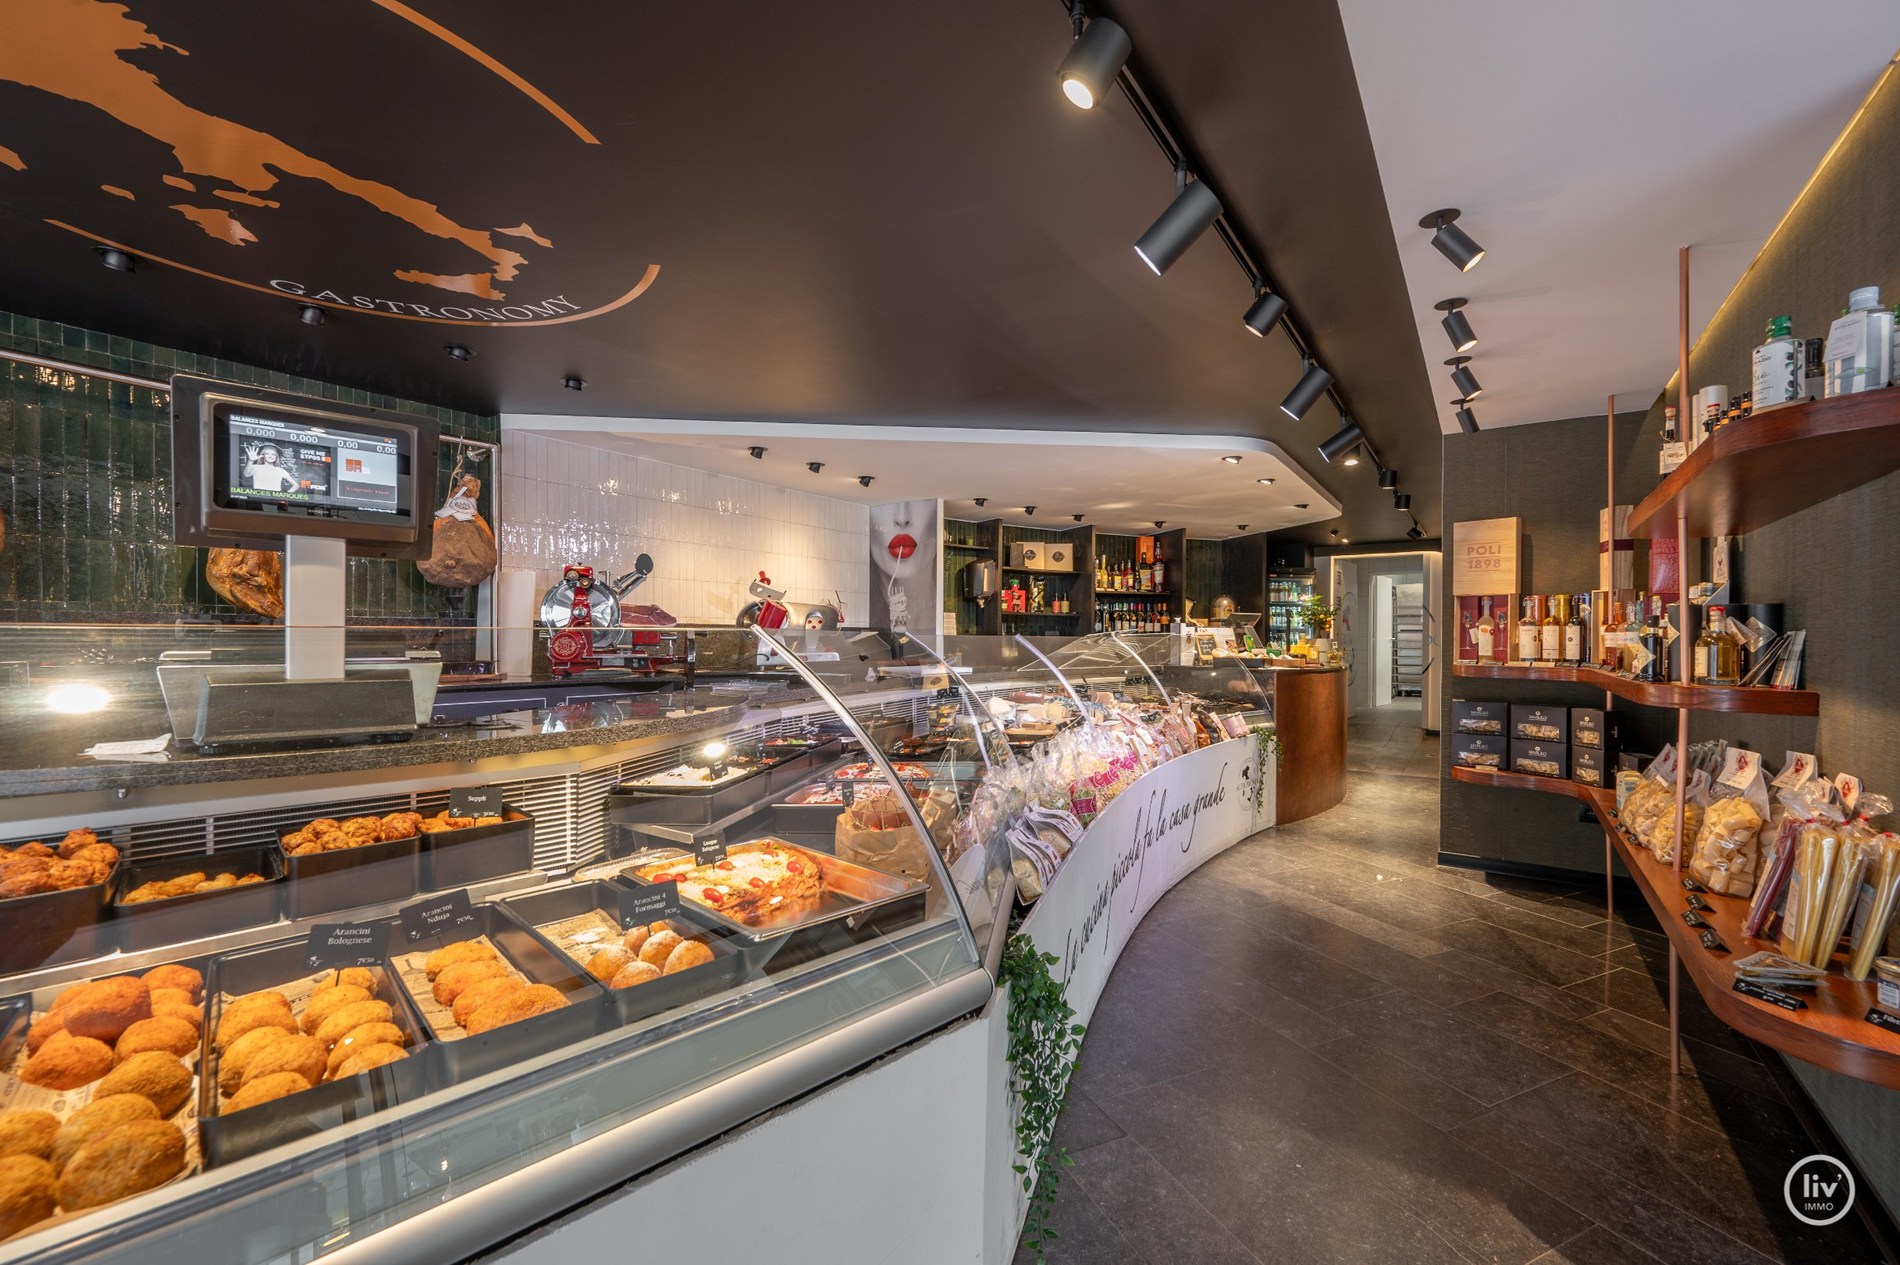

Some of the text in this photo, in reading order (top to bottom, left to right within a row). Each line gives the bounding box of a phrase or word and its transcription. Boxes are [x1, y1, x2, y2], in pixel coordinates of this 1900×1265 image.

[269, 279, 581, 321] GASTRONOMY
[230, 487, 309, 500] BALANCES MARQUES
[1467, 544, 1501, 556] POLI
[1467, 558, 1501, 569] 1898
[1103, 806, 1142, 956] piccola
[1130, 789, 1155, 914] fa
[1155, 788, 1168, 842] la
[1169, 802, 1192, 831] casa
[1181, 761, 1228, 854] grande
[633, 894, 660, 906] Arancini
[422, 904, 453, 918] Arancini
[635, 901, 666, 914] Formaggi
[427, 912, 450, 924] Nduja
[333, 927, 371, 936] Arancini
[327, 937, 372, 946] Bolognese
